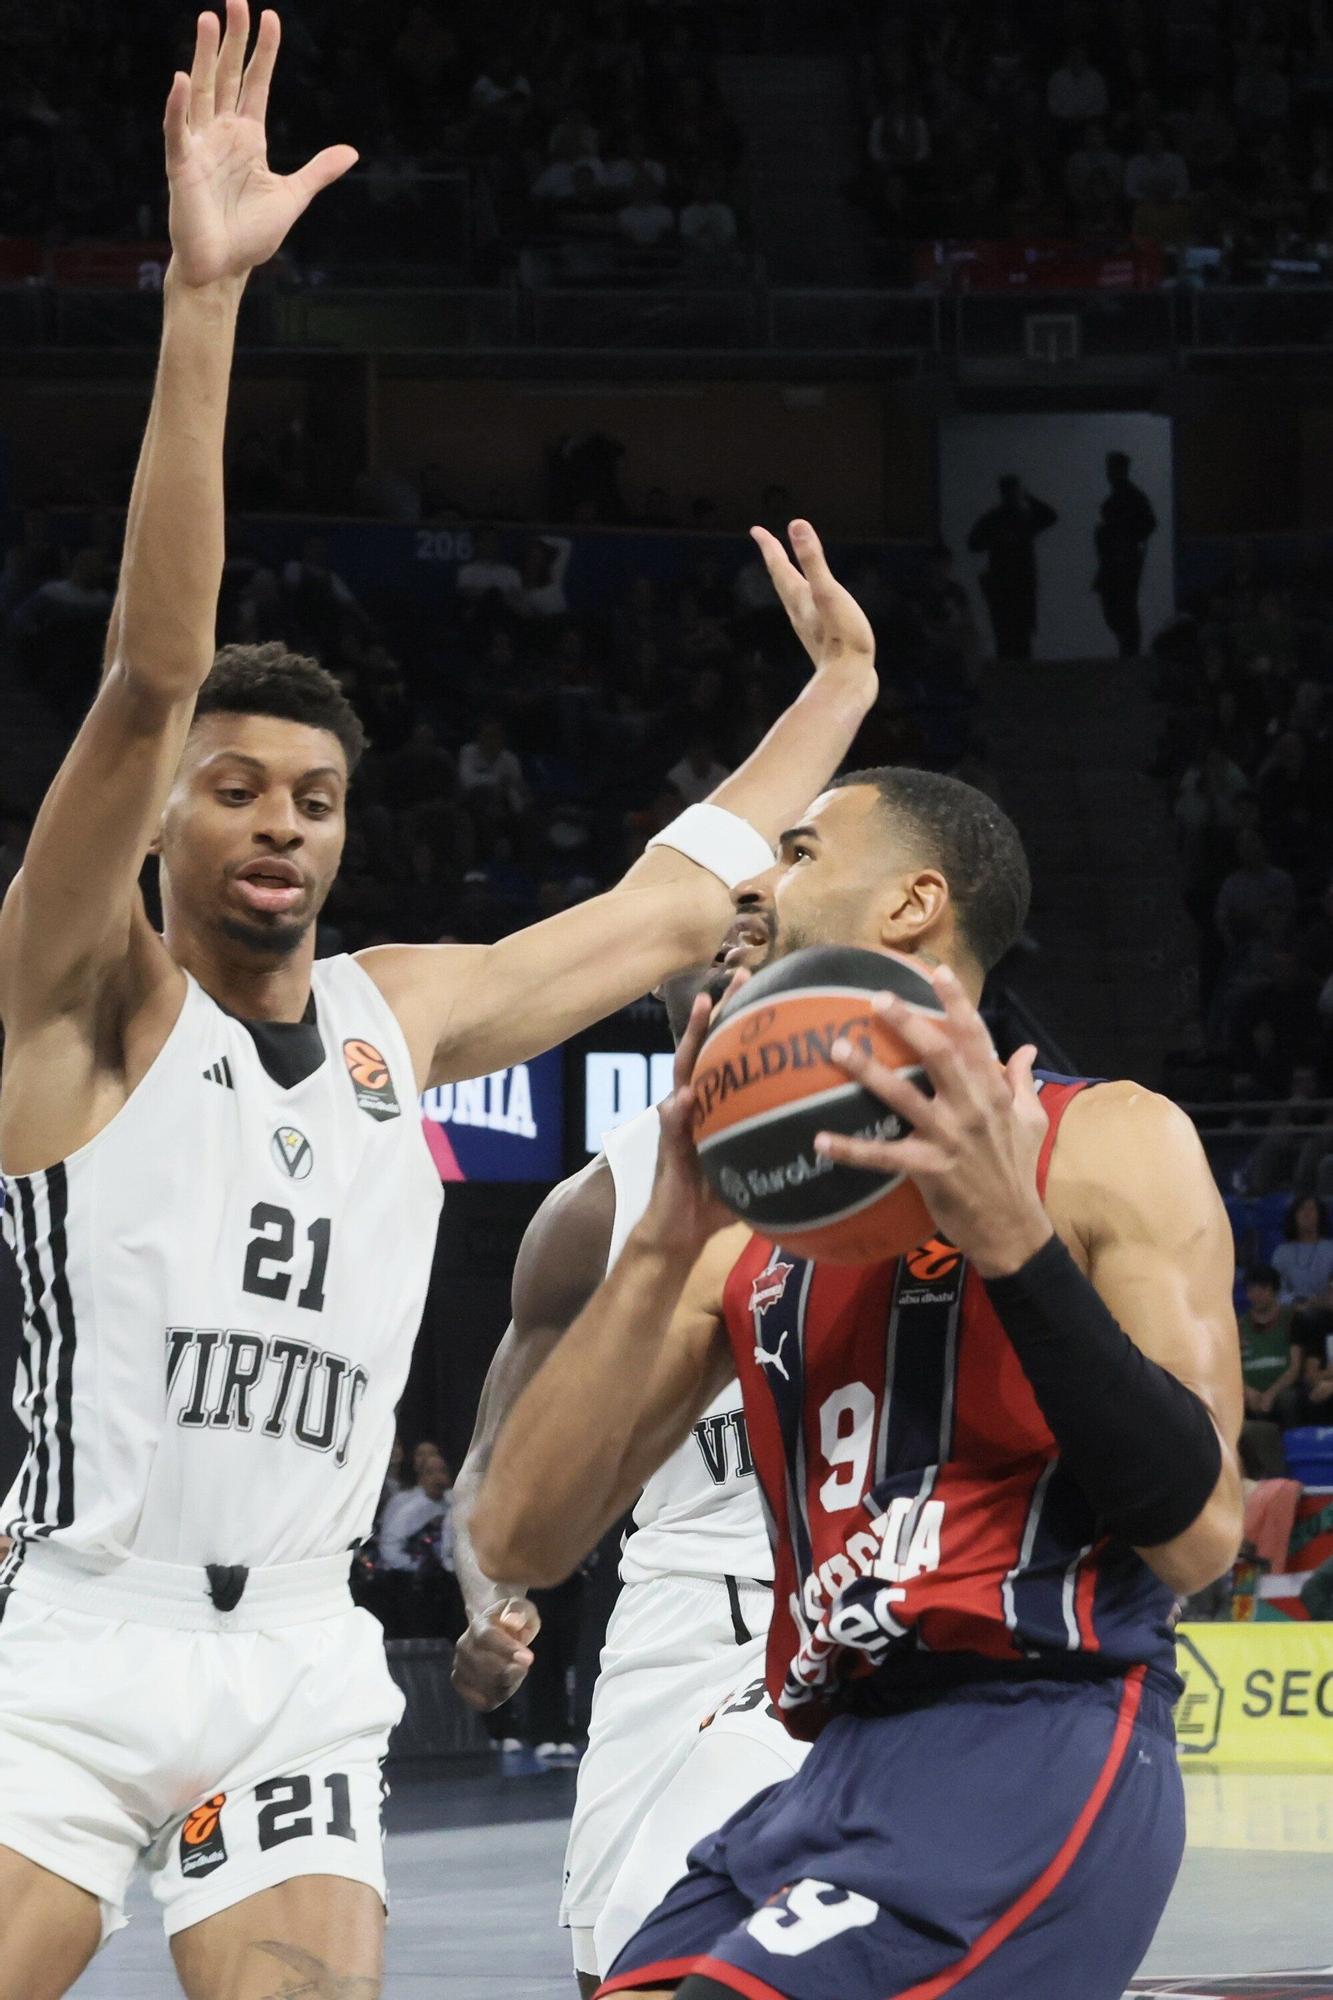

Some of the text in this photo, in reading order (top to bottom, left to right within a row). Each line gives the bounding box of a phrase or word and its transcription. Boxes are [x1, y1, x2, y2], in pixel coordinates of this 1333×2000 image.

[242, 1201, 332, 1312] 21
[819, 1381, 876, 1513] 9
[254, 1772, 358, 1852] 21
